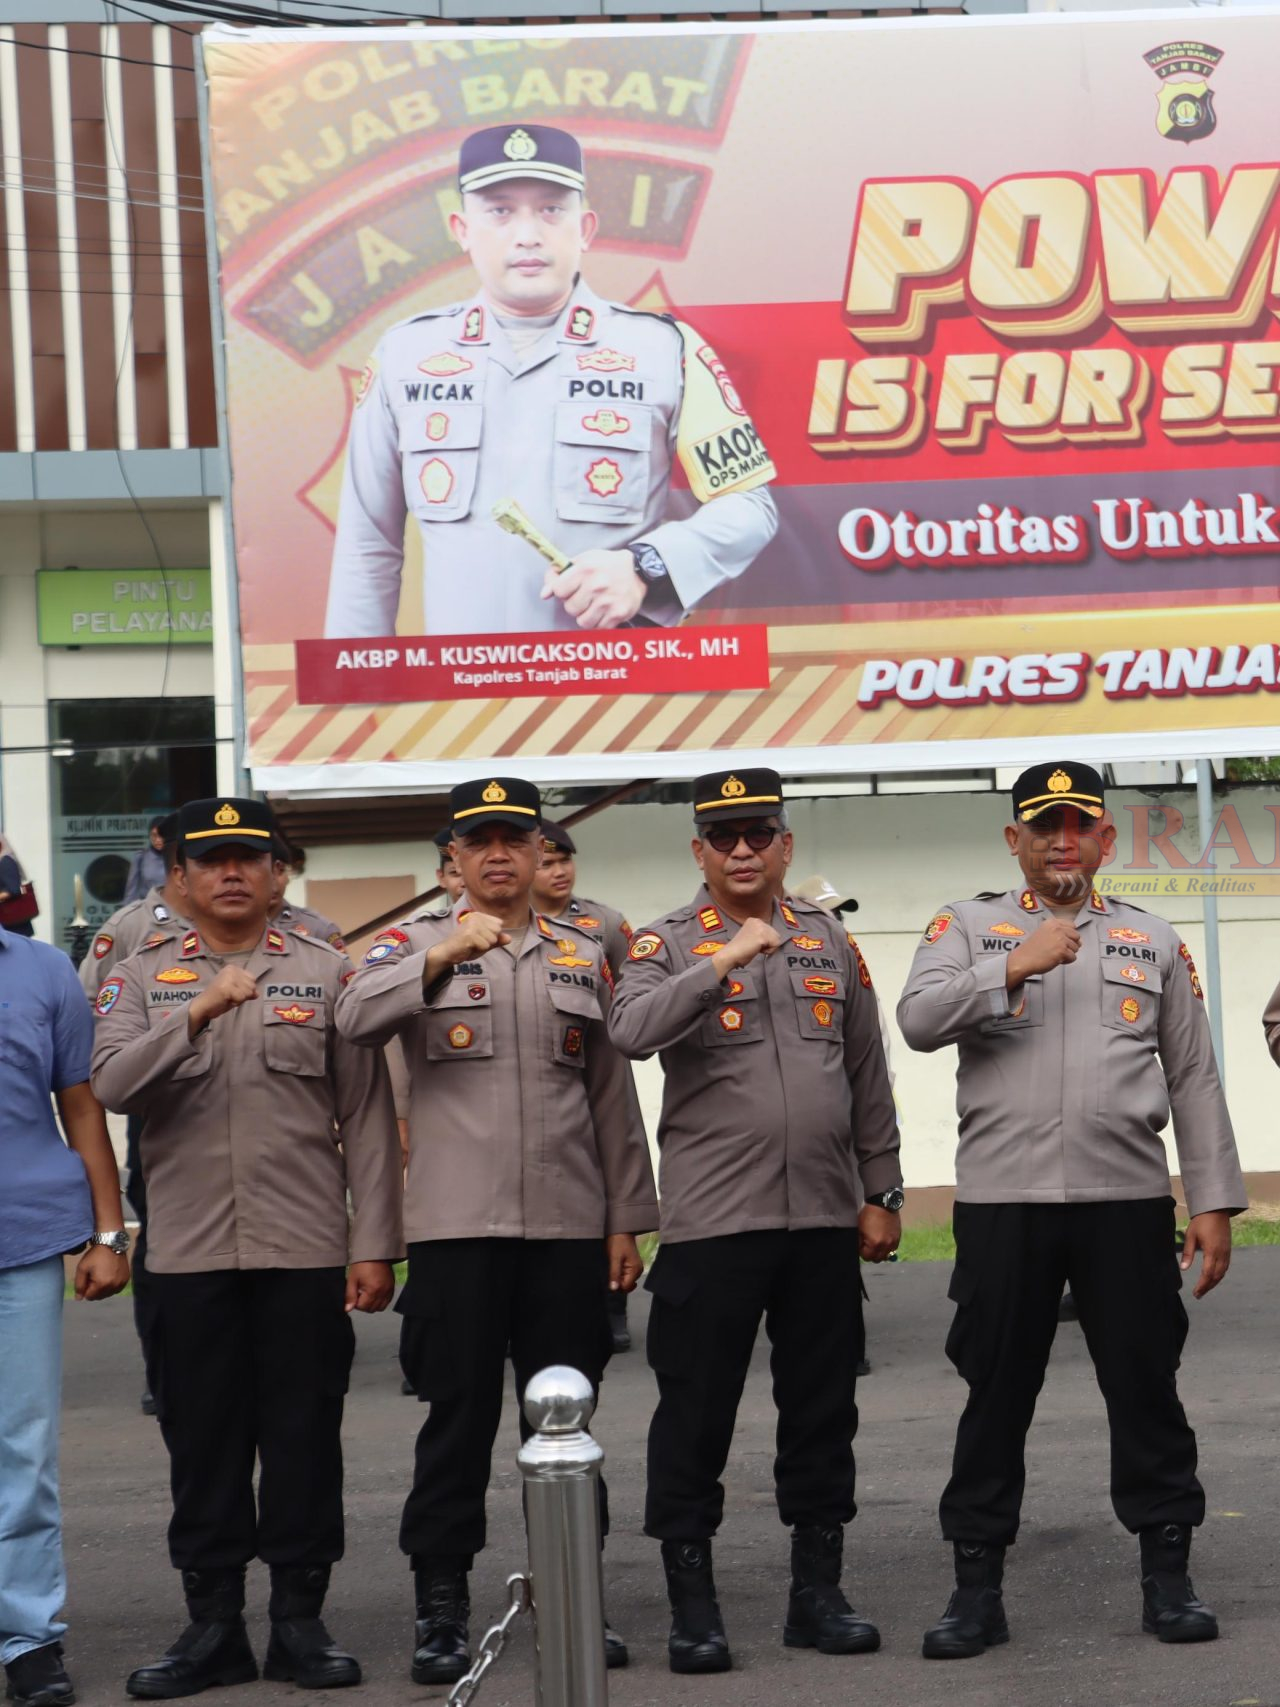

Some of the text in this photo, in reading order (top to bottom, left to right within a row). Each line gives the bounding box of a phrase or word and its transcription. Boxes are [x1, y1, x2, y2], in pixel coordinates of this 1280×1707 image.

[1163, 43, 1204, 52] POLRES
[1161, 62, 1208, 76] JAMBI
[217, 67, 708, 251] ANJAB BARAT
[405, 383, 475, 402] WICAK
[569, 379, 644, 401] POLRI
[808, 356, 914, 440] IS
[935, 348, 1140, 436] FOR
[710, 468, 739, 488] OPS
[838, 504, 1081, 563] Otoritas
[1093, 493, 1280, 552] Untuk
[112, 579, 197, 602] PINTU
[336, 637, 740, 670] AKBP M. KUSWICAKSONO, SIK., MH
[453, 667, 628, 687] Kapolres Tanjab Barat
[857, 652, 1086, 705] POLRES
[787, 956, 837, 970] POLRI
[1105, 944, 1156, 963] POLRI
[550, 971, 595, 989] POLRI
[266, 985, 322, 999] POLRI
